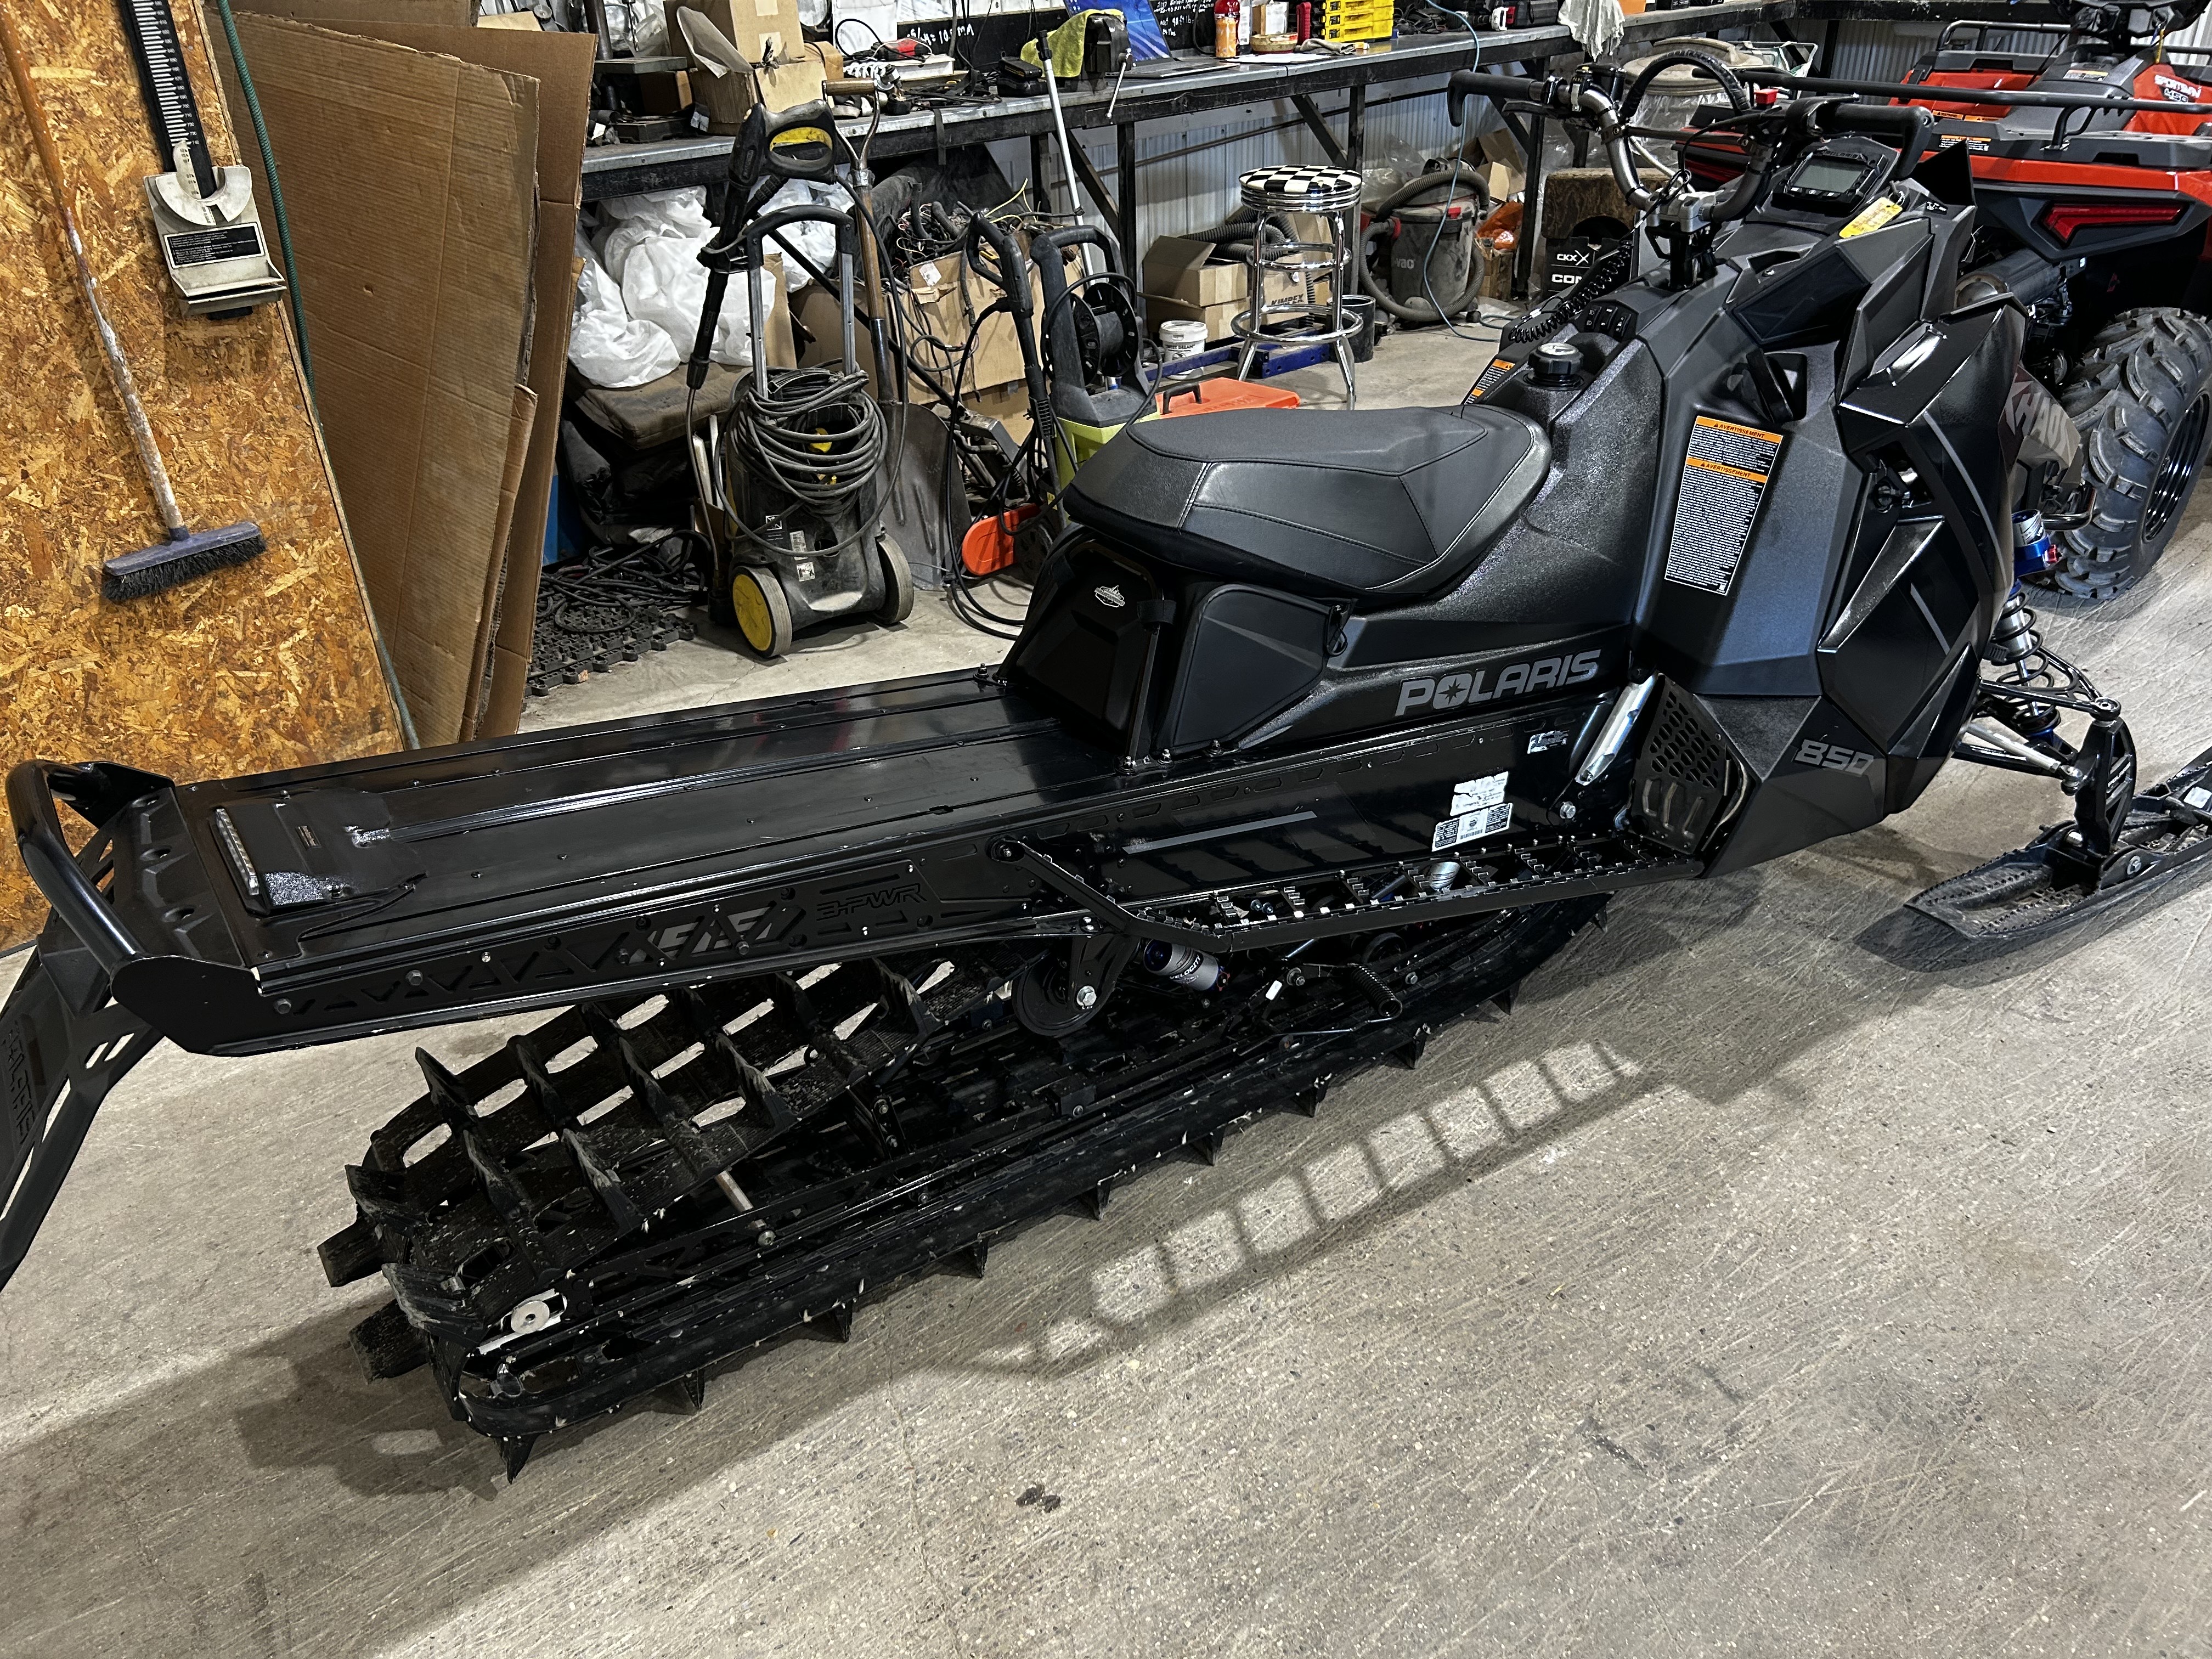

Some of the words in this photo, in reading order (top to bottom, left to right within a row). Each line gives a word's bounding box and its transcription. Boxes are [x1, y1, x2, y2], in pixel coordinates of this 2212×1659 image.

[1719, 424, 1765, 438] AVERTISSEMENT
[1706, 464, 1751, 478] AVERTISSEMENT
[1395, 649, 1601, 716] POLARIS
[1795, 739, 1874, 775] 850
[1169, 954, 1201, 979] VELOCITY
